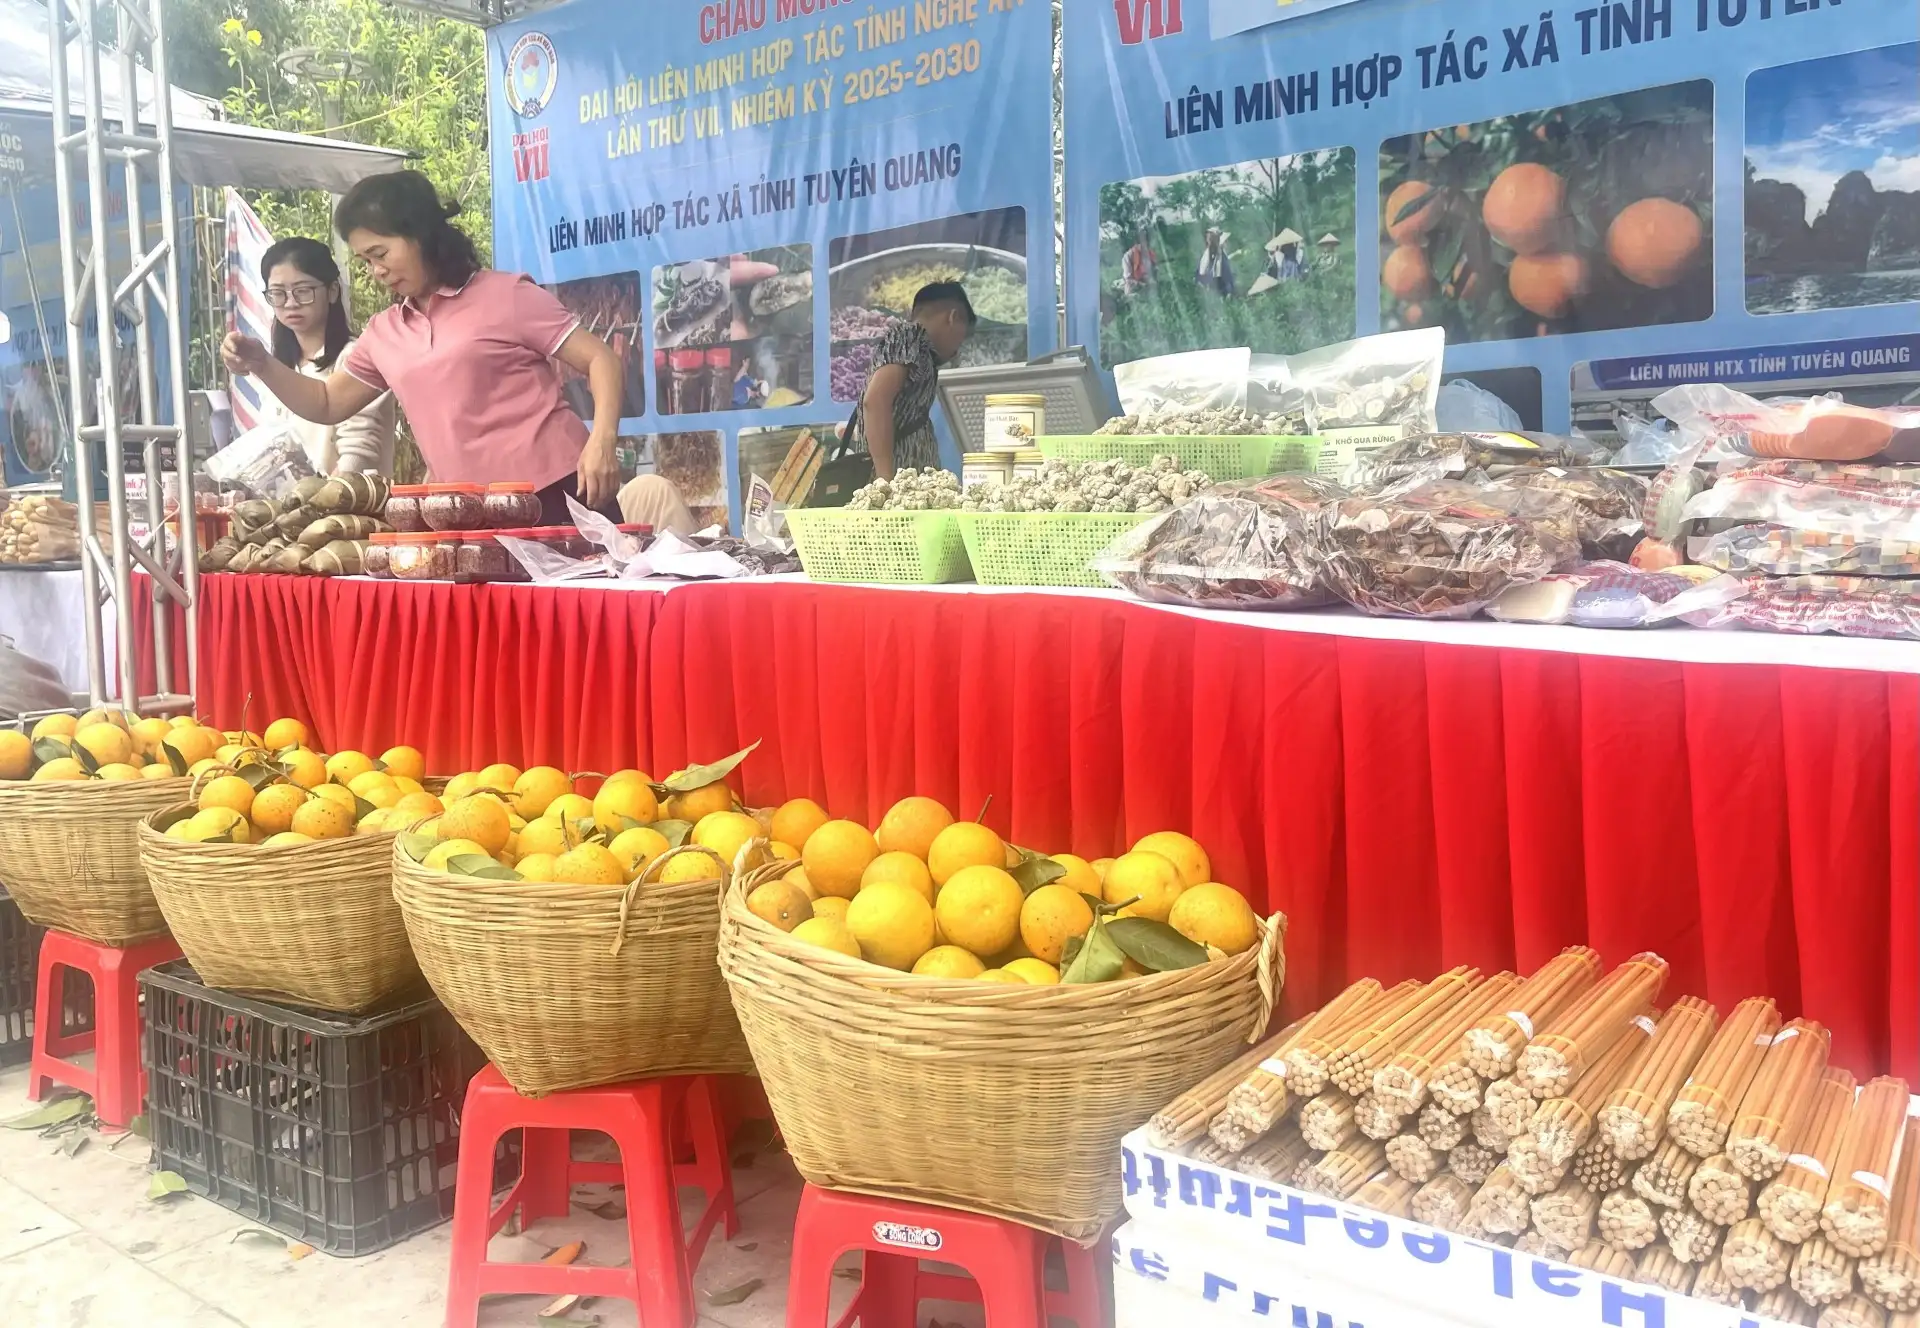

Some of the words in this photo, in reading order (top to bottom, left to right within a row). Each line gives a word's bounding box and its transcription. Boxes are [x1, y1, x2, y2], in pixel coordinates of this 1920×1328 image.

[579, 88, 608, 125] ĐẠI
[614, 72, 643, 117] HỘI
[650, 63, 688, 106] LIÊN
[694, 52, 744, 94] MINH
[752, 37, 793, 80] HỢP
[803, 21, 845, 65] TÁC
[854, 5, 906, 52] TỈNH
[607, 113, 642, 159] LẦN
[647, 108, 686, 149] THỨ
[693, 105, 724, 140] VII,
[731, 82, 795, 130] NHIỆM
[803, 68, 834, 114] KỲ
[843, 38, 981, 104] 2025-2030
[1165, 84, 1224, 139] LIÊN
[1234, 71, 1318, 125] MINH
[1332, 52, 1402, 110] HỢP
[1415, 29, 1488, 90] TÁC
[1501, 10, 1559, 73] XÃ
[513, 143, 549, 182] VII
[549, 216, 578, 254] LIÊN
[584, 212, 626, 246] MINH
[631, 202, 666, 240] HỢP
[672, 190, 710, 229] TÁC
[716, 182, 743, 224] XÃ
[749, 173, 796, 216] TỈNH
[803, 157, 876, 206] TUYÊN
[884, 142, 961, 192] QUANG
[1629, 361, 1663, 382] LIÊN
[1668, 363, 1709, 379] MINH
[1714, 362, 1744, 377] HTX
[1749, 353, 1786, 374] TỈNH
[1792, 349, 1845, 372] TUYÊN
[1851, 346, 1910, 368] QUANG
[1353, 436, 1371, 445] QUA
